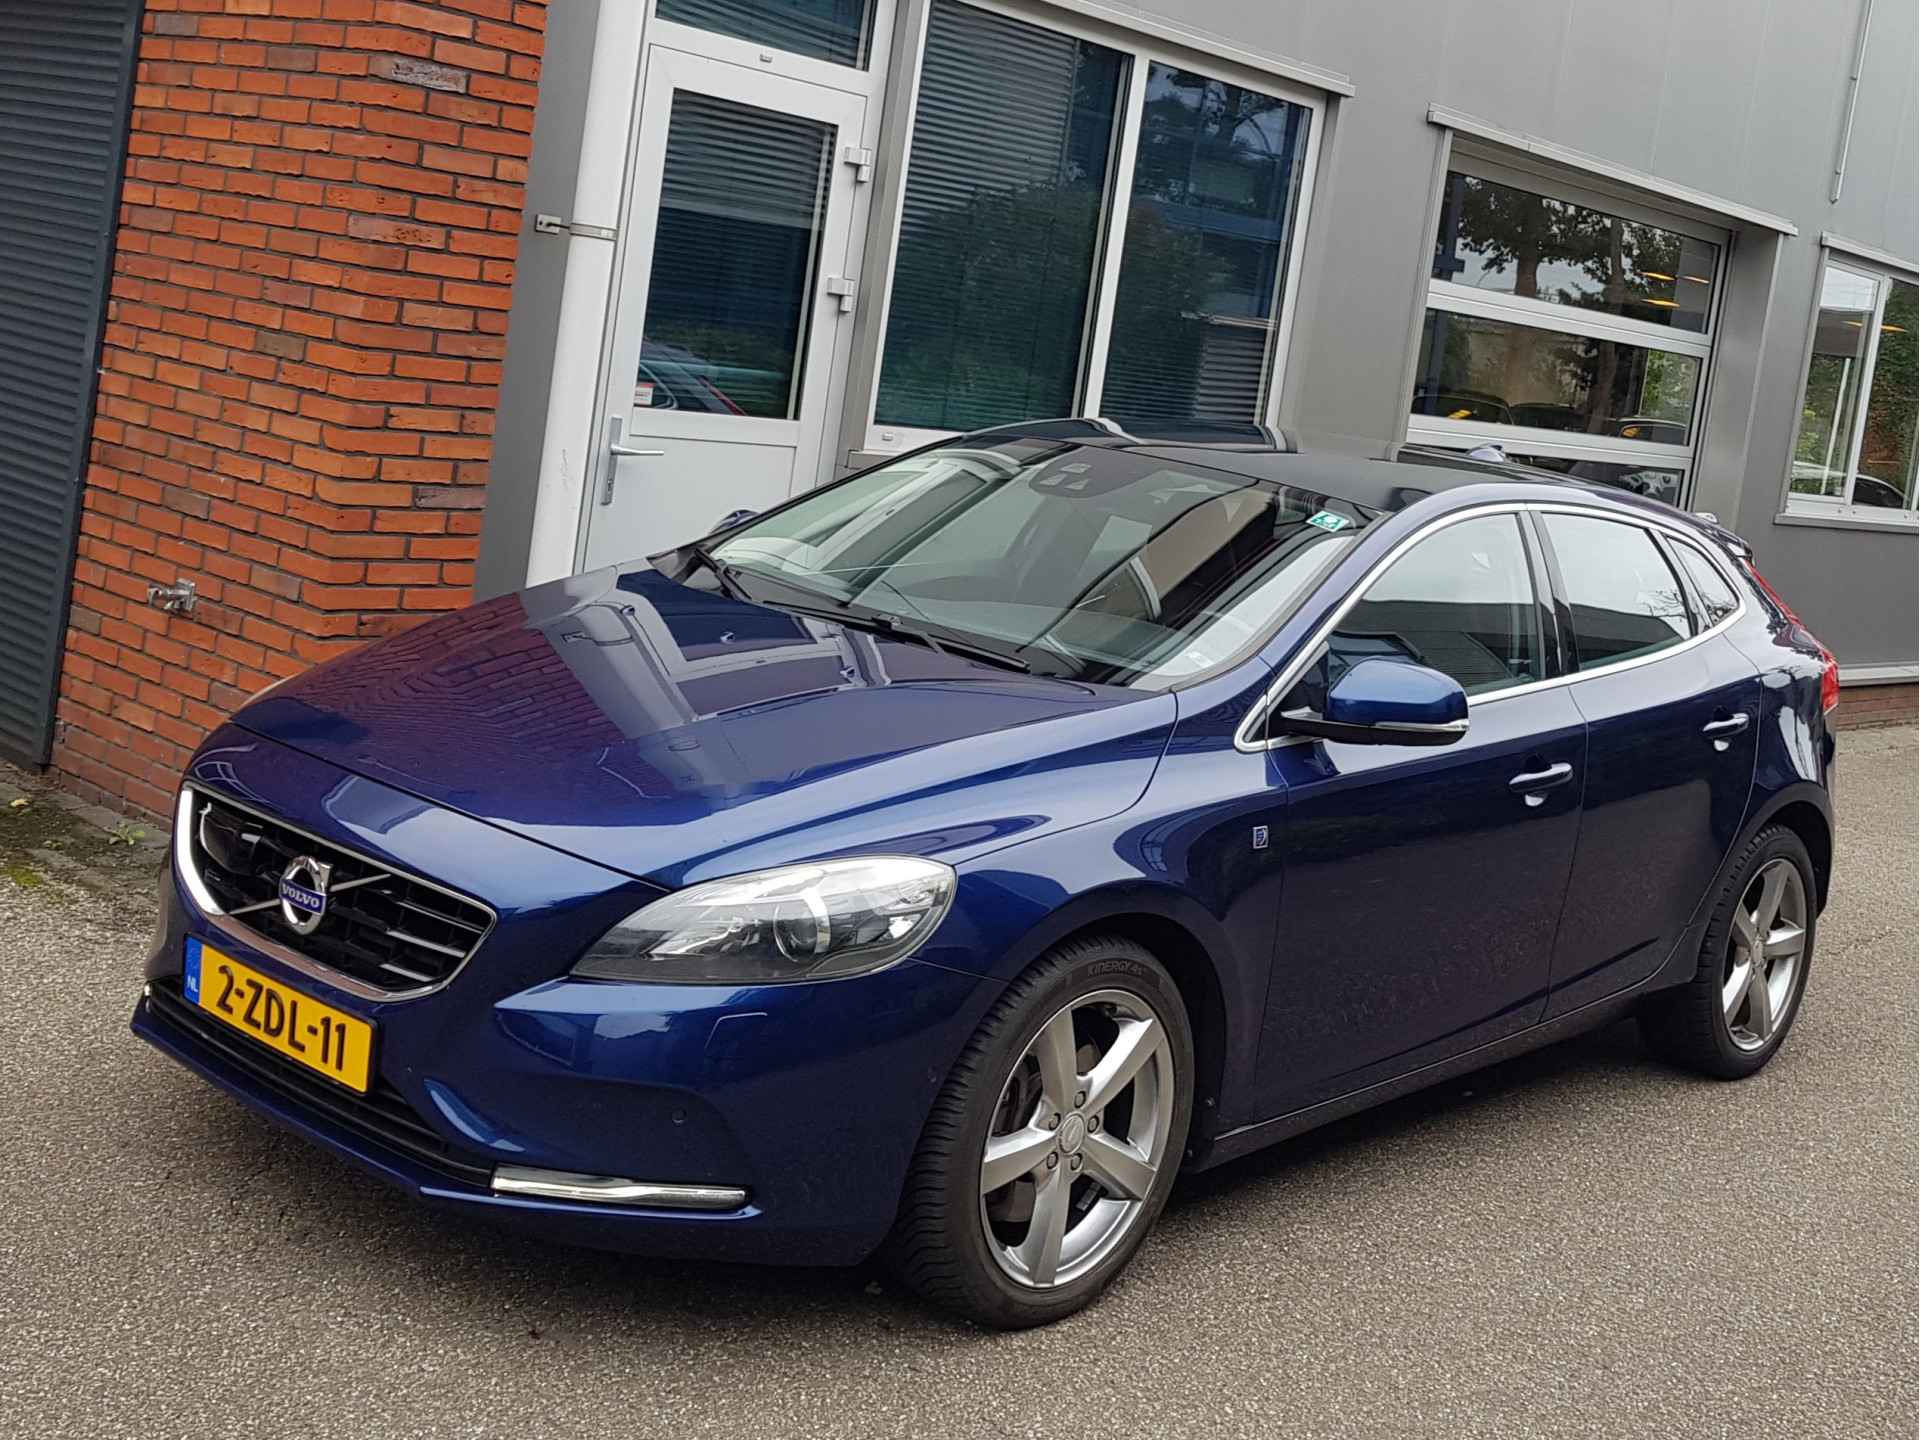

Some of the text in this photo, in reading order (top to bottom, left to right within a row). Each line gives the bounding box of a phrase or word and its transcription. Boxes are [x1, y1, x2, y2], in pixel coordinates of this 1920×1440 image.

[282, 882, 320, 908] VOLVO
[186, 974, 199, 992] NL
[216, 965, 346, 1072] 2-ZDL-11
